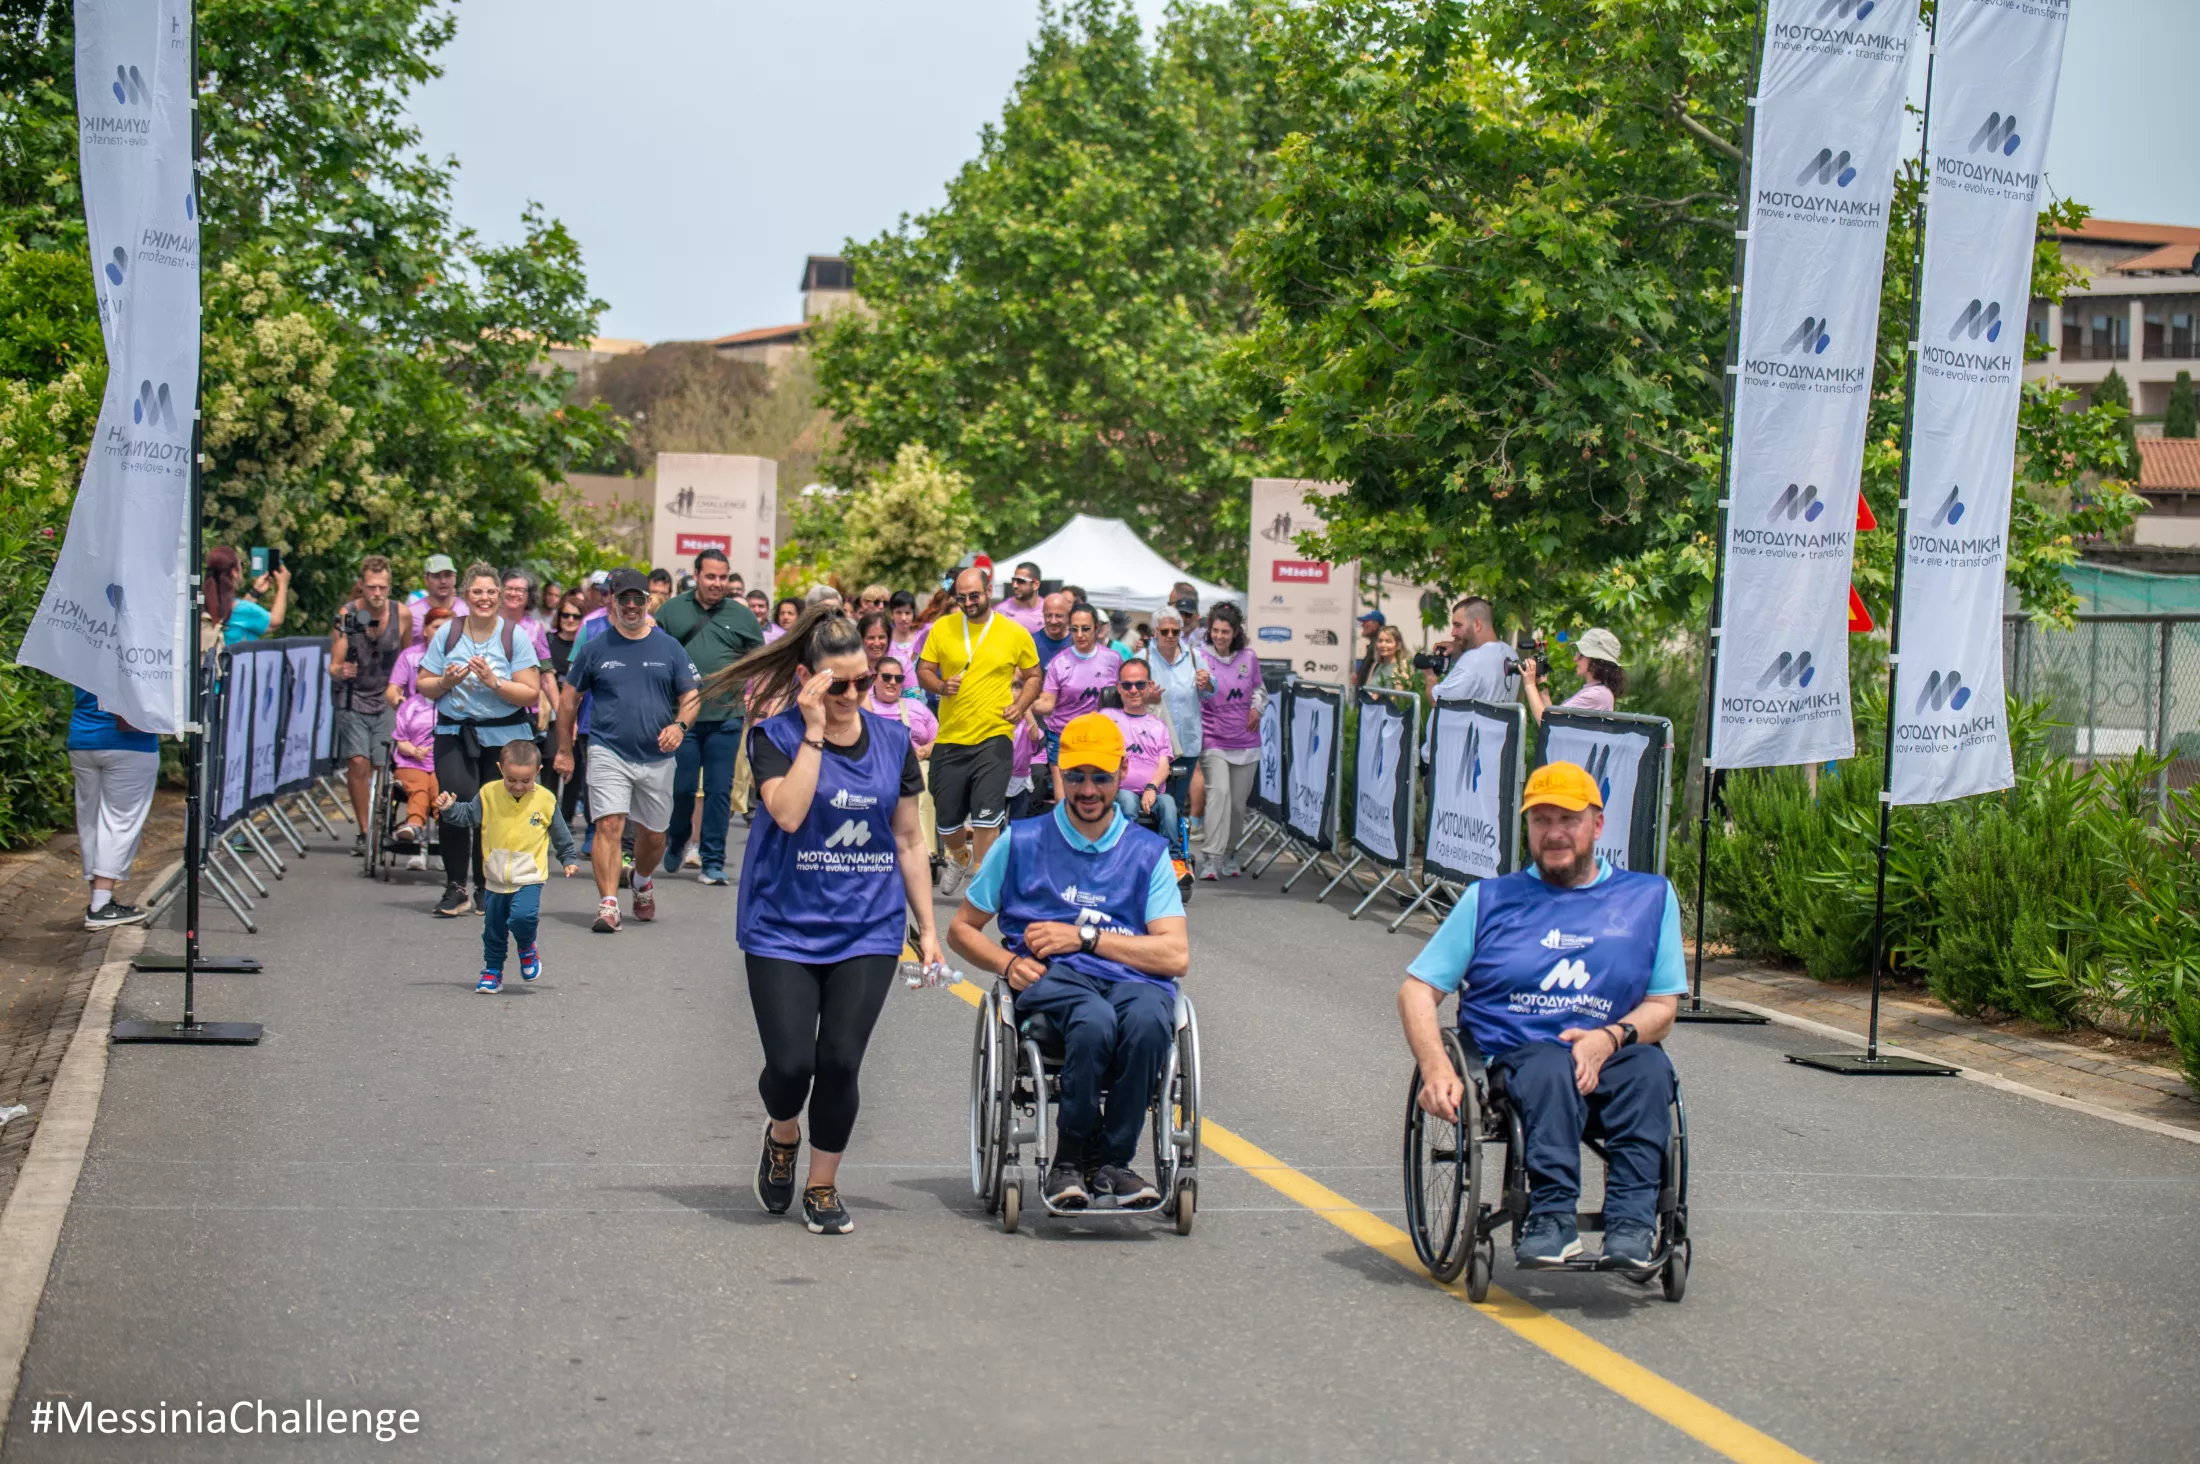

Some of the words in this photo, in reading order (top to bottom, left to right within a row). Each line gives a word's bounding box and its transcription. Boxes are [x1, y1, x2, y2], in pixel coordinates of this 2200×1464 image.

[2022, 4, 2068, 21] transform
[1774, 24, 1907, 51] ΜΟΤΟΔΥΝΑΜΙΚΗ
[1773, 41, 1802, 51] move
[1811, 43, 1844, 56] evolve
[1936, 176, 1957, 189] move
[1964, 182, 1995, 196] evolve
[1756, 207, 1785, 218] move
[1793, 212, 1829, 223] evolve
[1745, 359, 1865, 381] ΜΟΤΟΔΥΝΑΜΙΚΗ
[1946, 370, 1978, 382] evolve
[1744, 377, 1769, 387] move
[1778, 379, 1807, 391] evolve
[1814, 382, 1864, 394] transform
[1732, 528, 1850, 548] ΜΟΤΟΔΥΝΑΜΙΚ
[1732, 545, 1757, 555] move
[1765, 547, 1798, 559] evolve
[1951, 553, 2003, 568] transform
[1278, 566, 1324, 578] Miele
[1319, 664, 1339, 672] NIO
[1720, 714, 1746, 724] move
[1755, 714, 1791, 725] evolve
[1914, 741, 1949, 754] evolve
[797, 851, 894, 865] ΜΟΤΟΔΥΝΑΜΙΚΗ
[796, 863, 819, 871] move
[825, 864, 850, 872] evolve
[857, 863, 893, 873] transform
[1509, 992, 1613, 1013] ΜΟΤΟΔΥΝΑΜΙΚΗ
